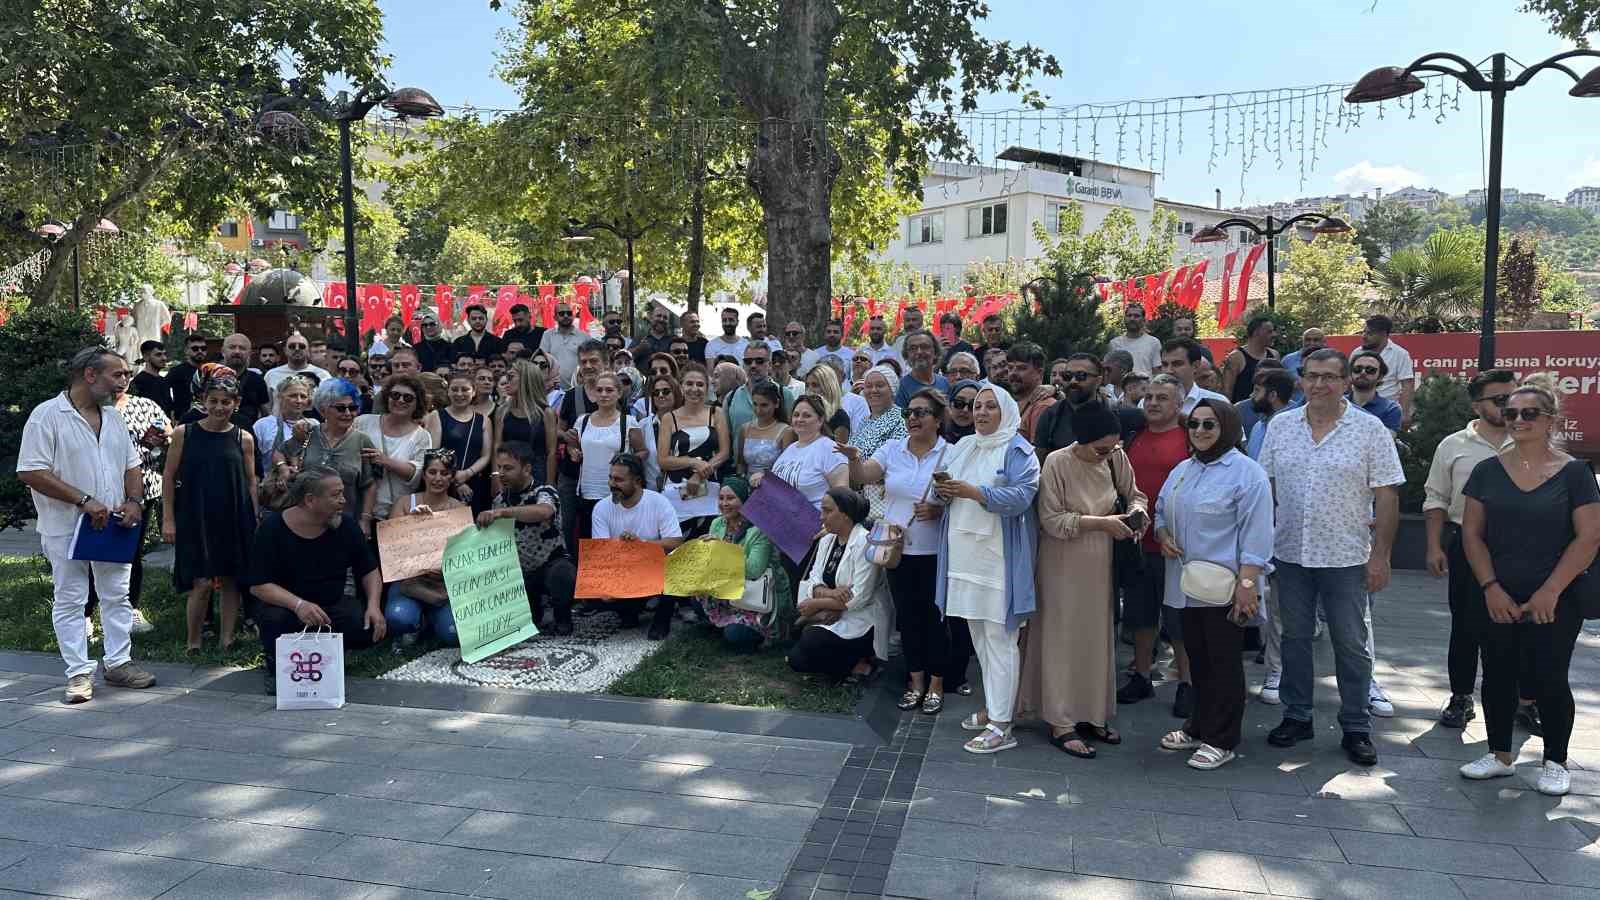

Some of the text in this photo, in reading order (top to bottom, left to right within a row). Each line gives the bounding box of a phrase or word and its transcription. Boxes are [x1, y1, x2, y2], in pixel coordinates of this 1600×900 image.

[1075, 182, 1122, 199] Garanti BBVA
[1422, 358, 1457, 368] canı
[1462, 357, 1540, 370] paasına
[444, 551, 474, 572] PAZAR
